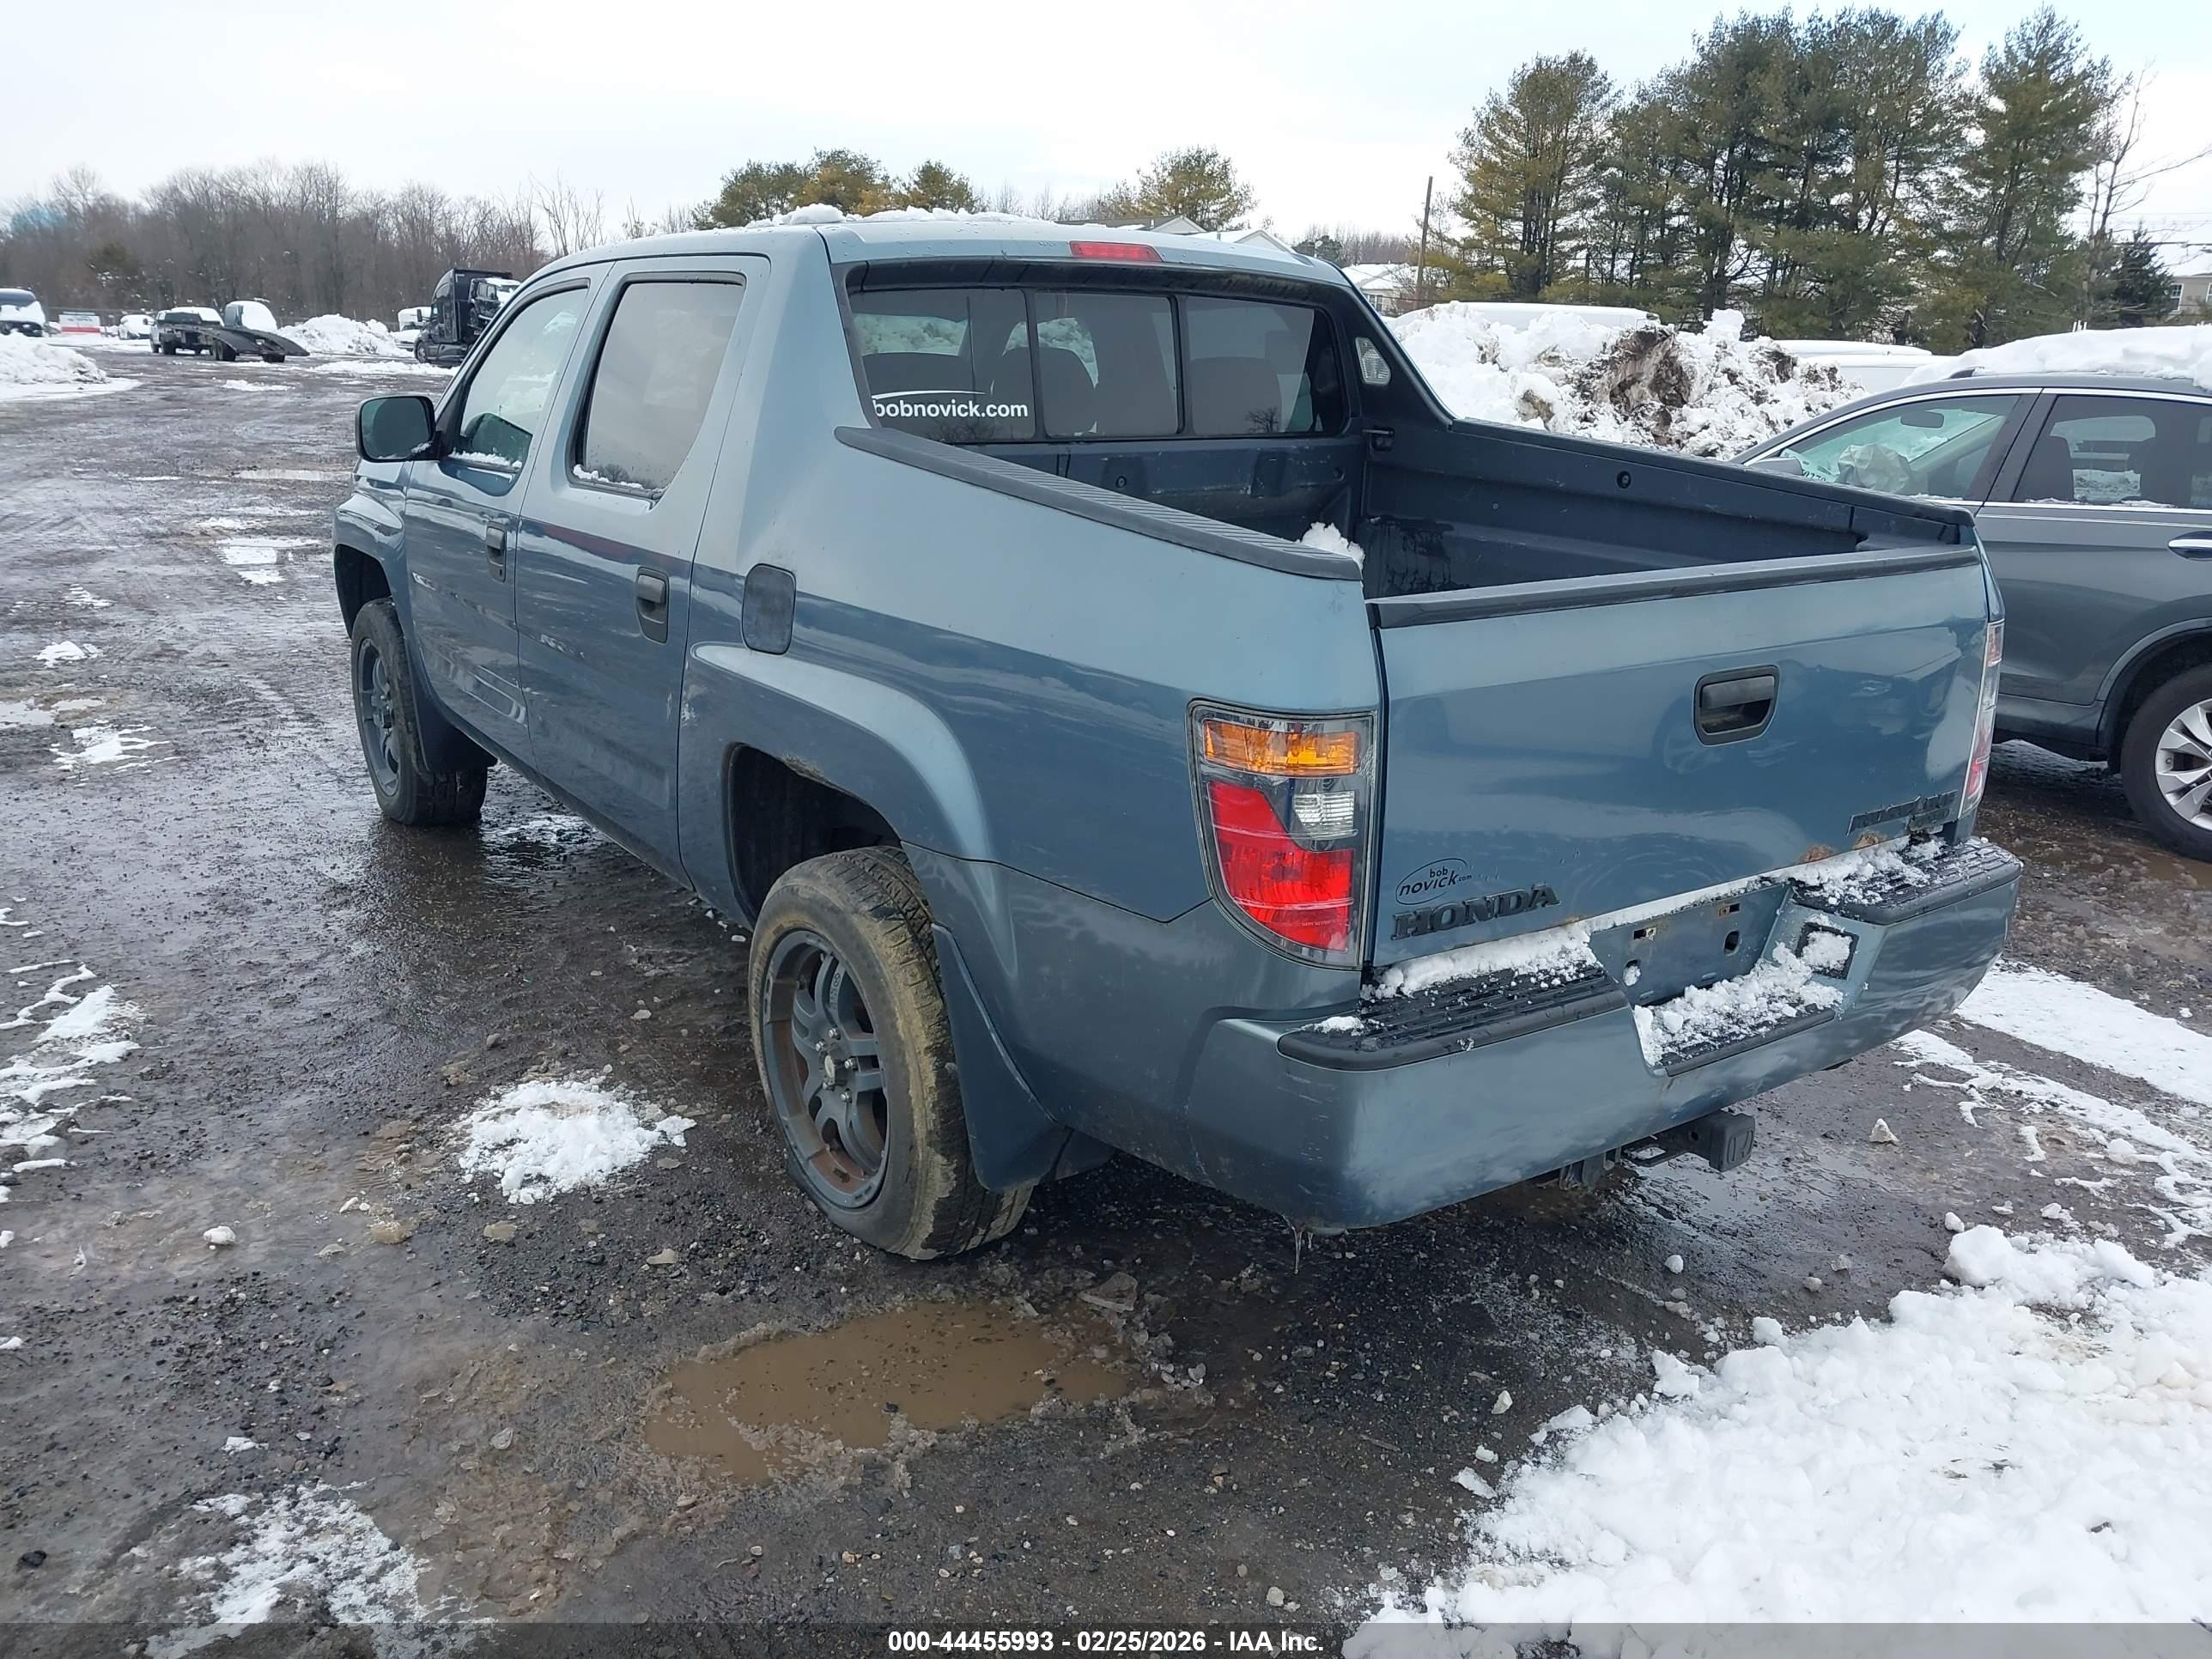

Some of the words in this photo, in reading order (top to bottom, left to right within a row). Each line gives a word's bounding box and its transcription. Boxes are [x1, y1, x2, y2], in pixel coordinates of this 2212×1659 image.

[872, 398, 1029, 418] bobnovick.com
[1429, 866, 1449, 878] bob
[1391, 882, 1562, 940] HONDA
